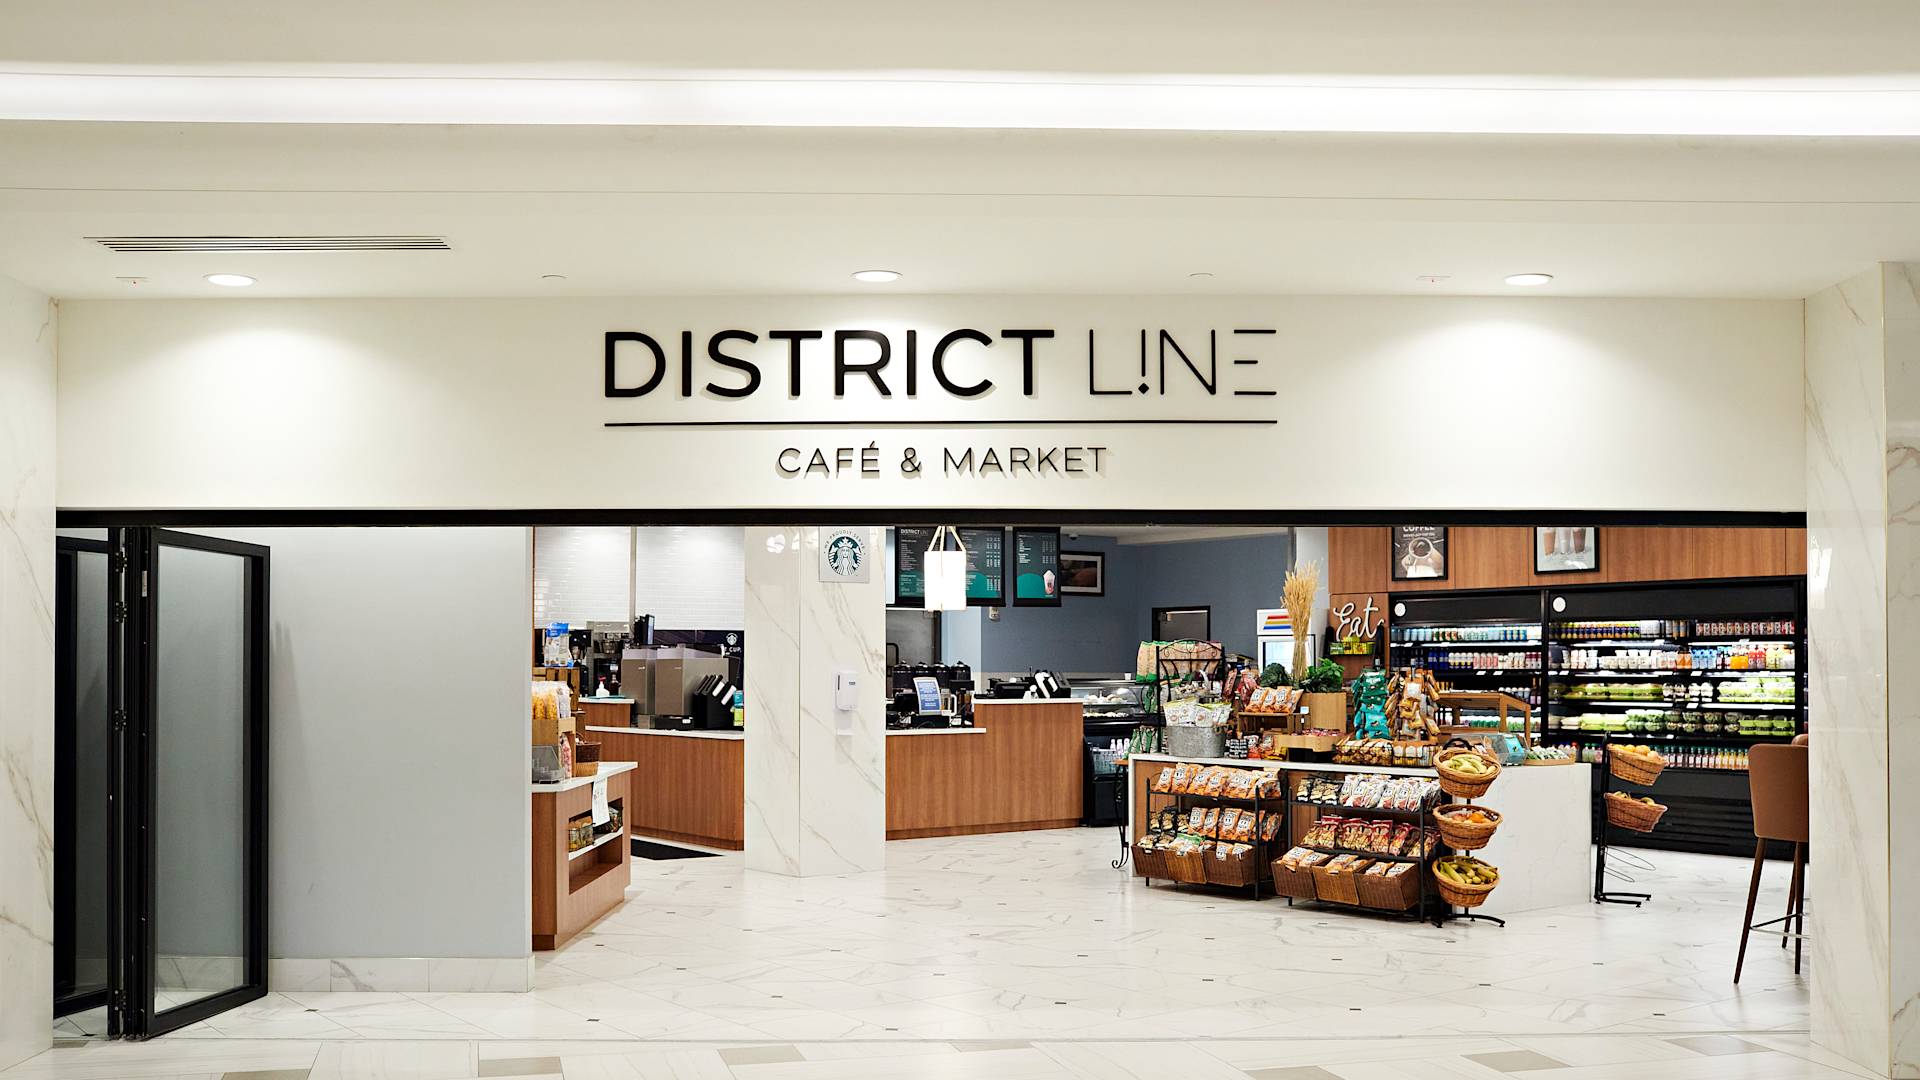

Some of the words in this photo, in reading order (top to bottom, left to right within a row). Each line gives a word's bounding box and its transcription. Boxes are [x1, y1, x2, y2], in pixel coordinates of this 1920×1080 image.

[604, 328, 1055, 398] DISTRICT
[778, 440, 880, 473] CAFÉ
[900, 447, 923, 473] &
[943, 447, 1108, 473] MARKET
[1332, 596, 1385, 642] Eat
